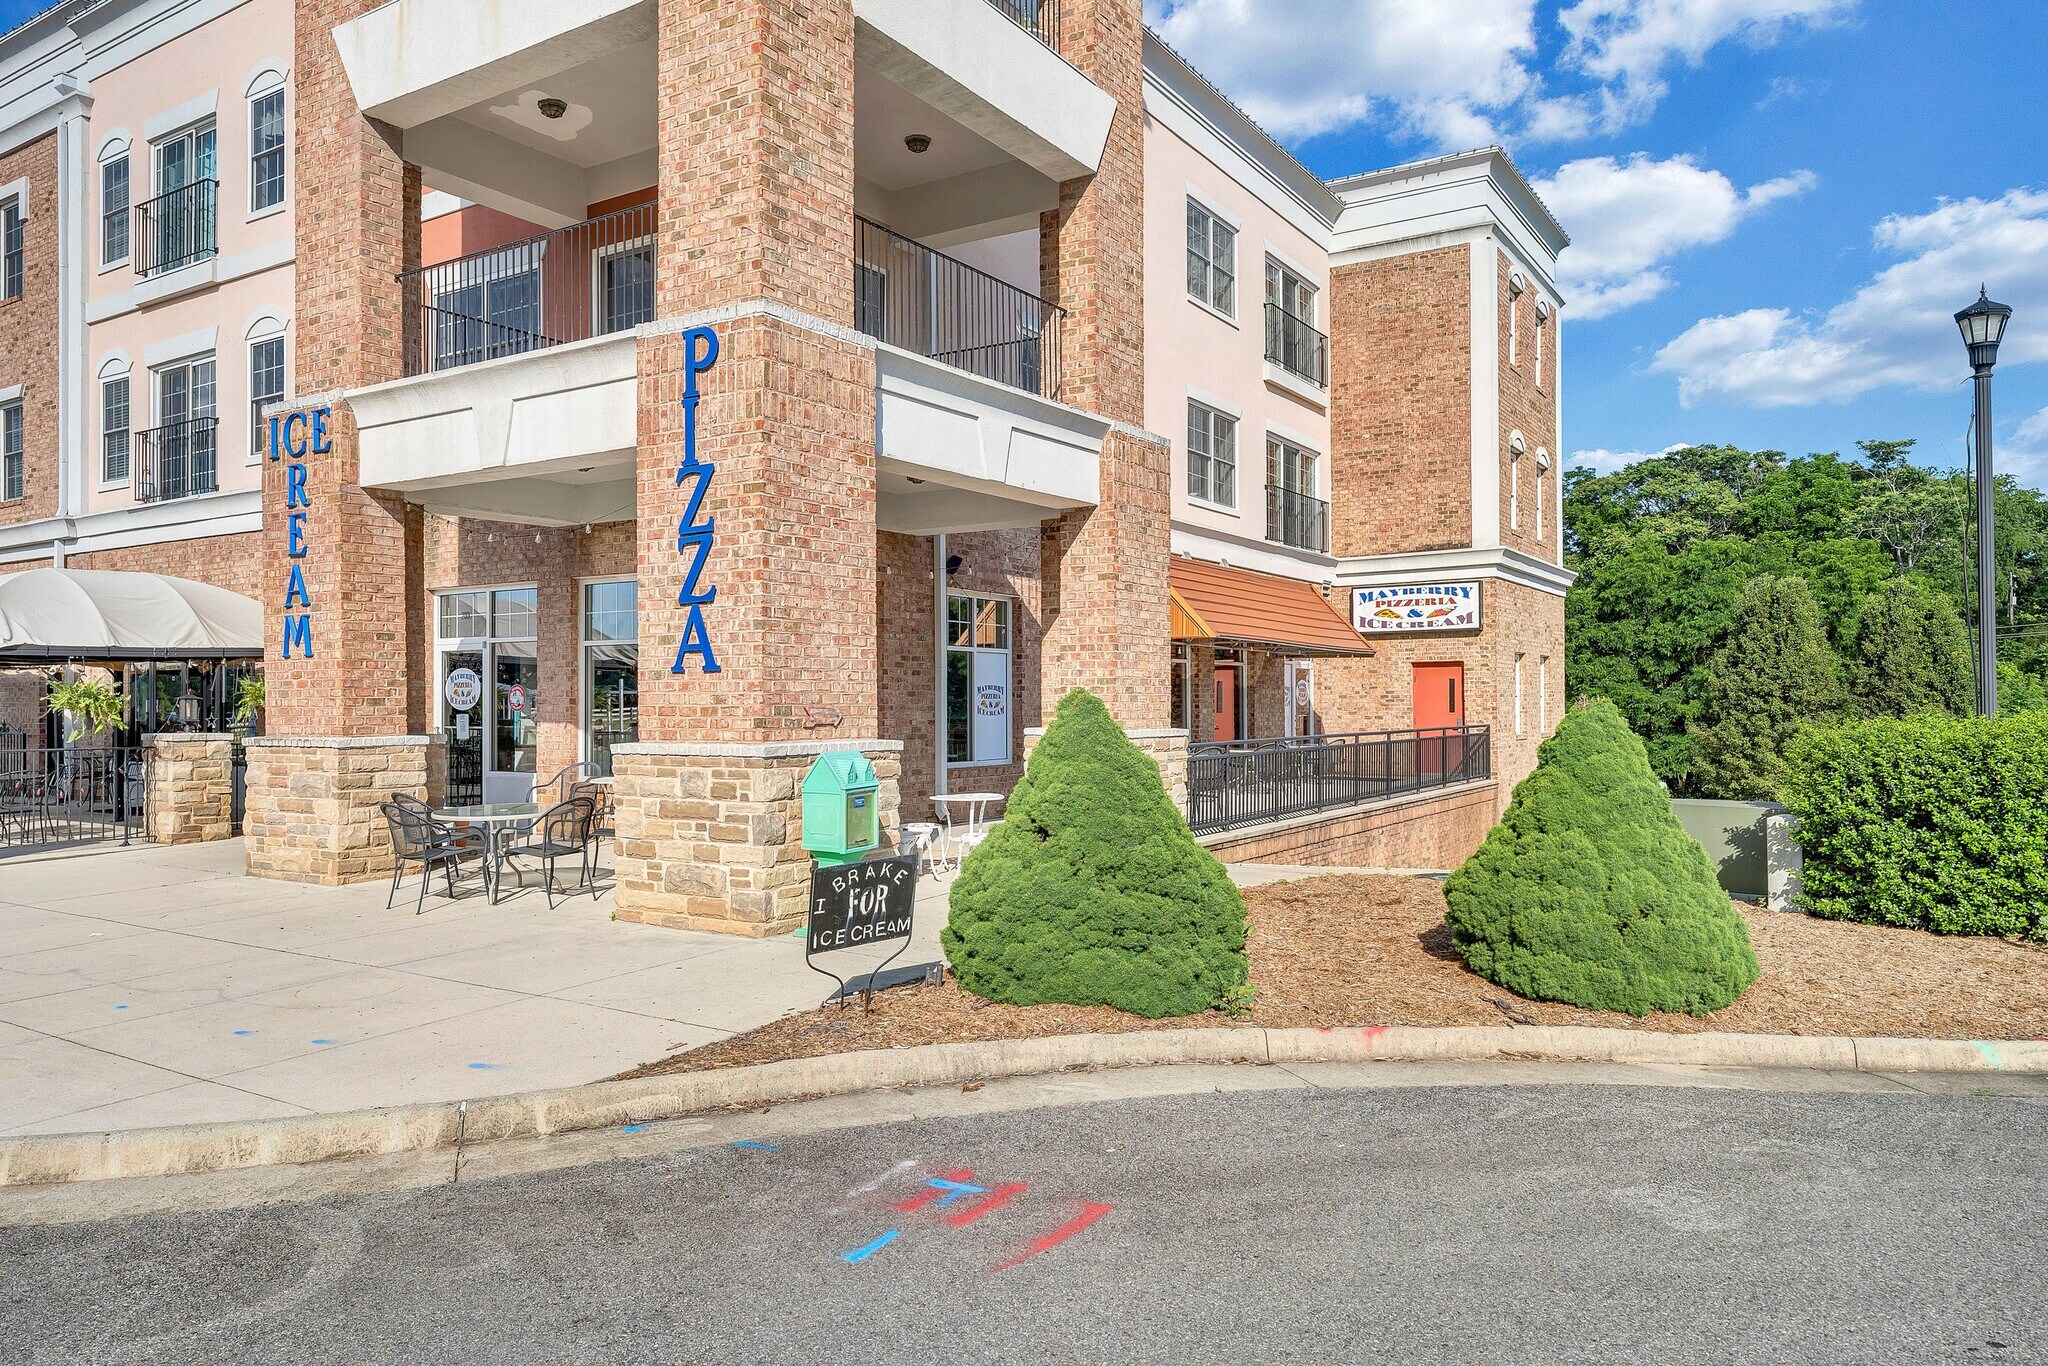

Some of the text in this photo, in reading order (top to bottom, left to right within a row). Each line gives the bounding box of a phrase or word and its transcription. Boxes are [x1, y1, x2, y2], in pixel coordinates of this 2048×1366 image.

[269, 407, 332, 461] ICE
[672, 327, 721, 674] PIZZA
[1359, 586, 1473, 605] MAYBERRY
[1375, 597, 1457, 608] PIZZERIA
[1359, 611, 1474, 628] ICE CREAM
[1407, 608, 1424, 618] &
[814, 862, 909, 915] I BRAKE
[849, 884, 888, 917] FOR
[813, 917, 911, 949] ICE CREAM
